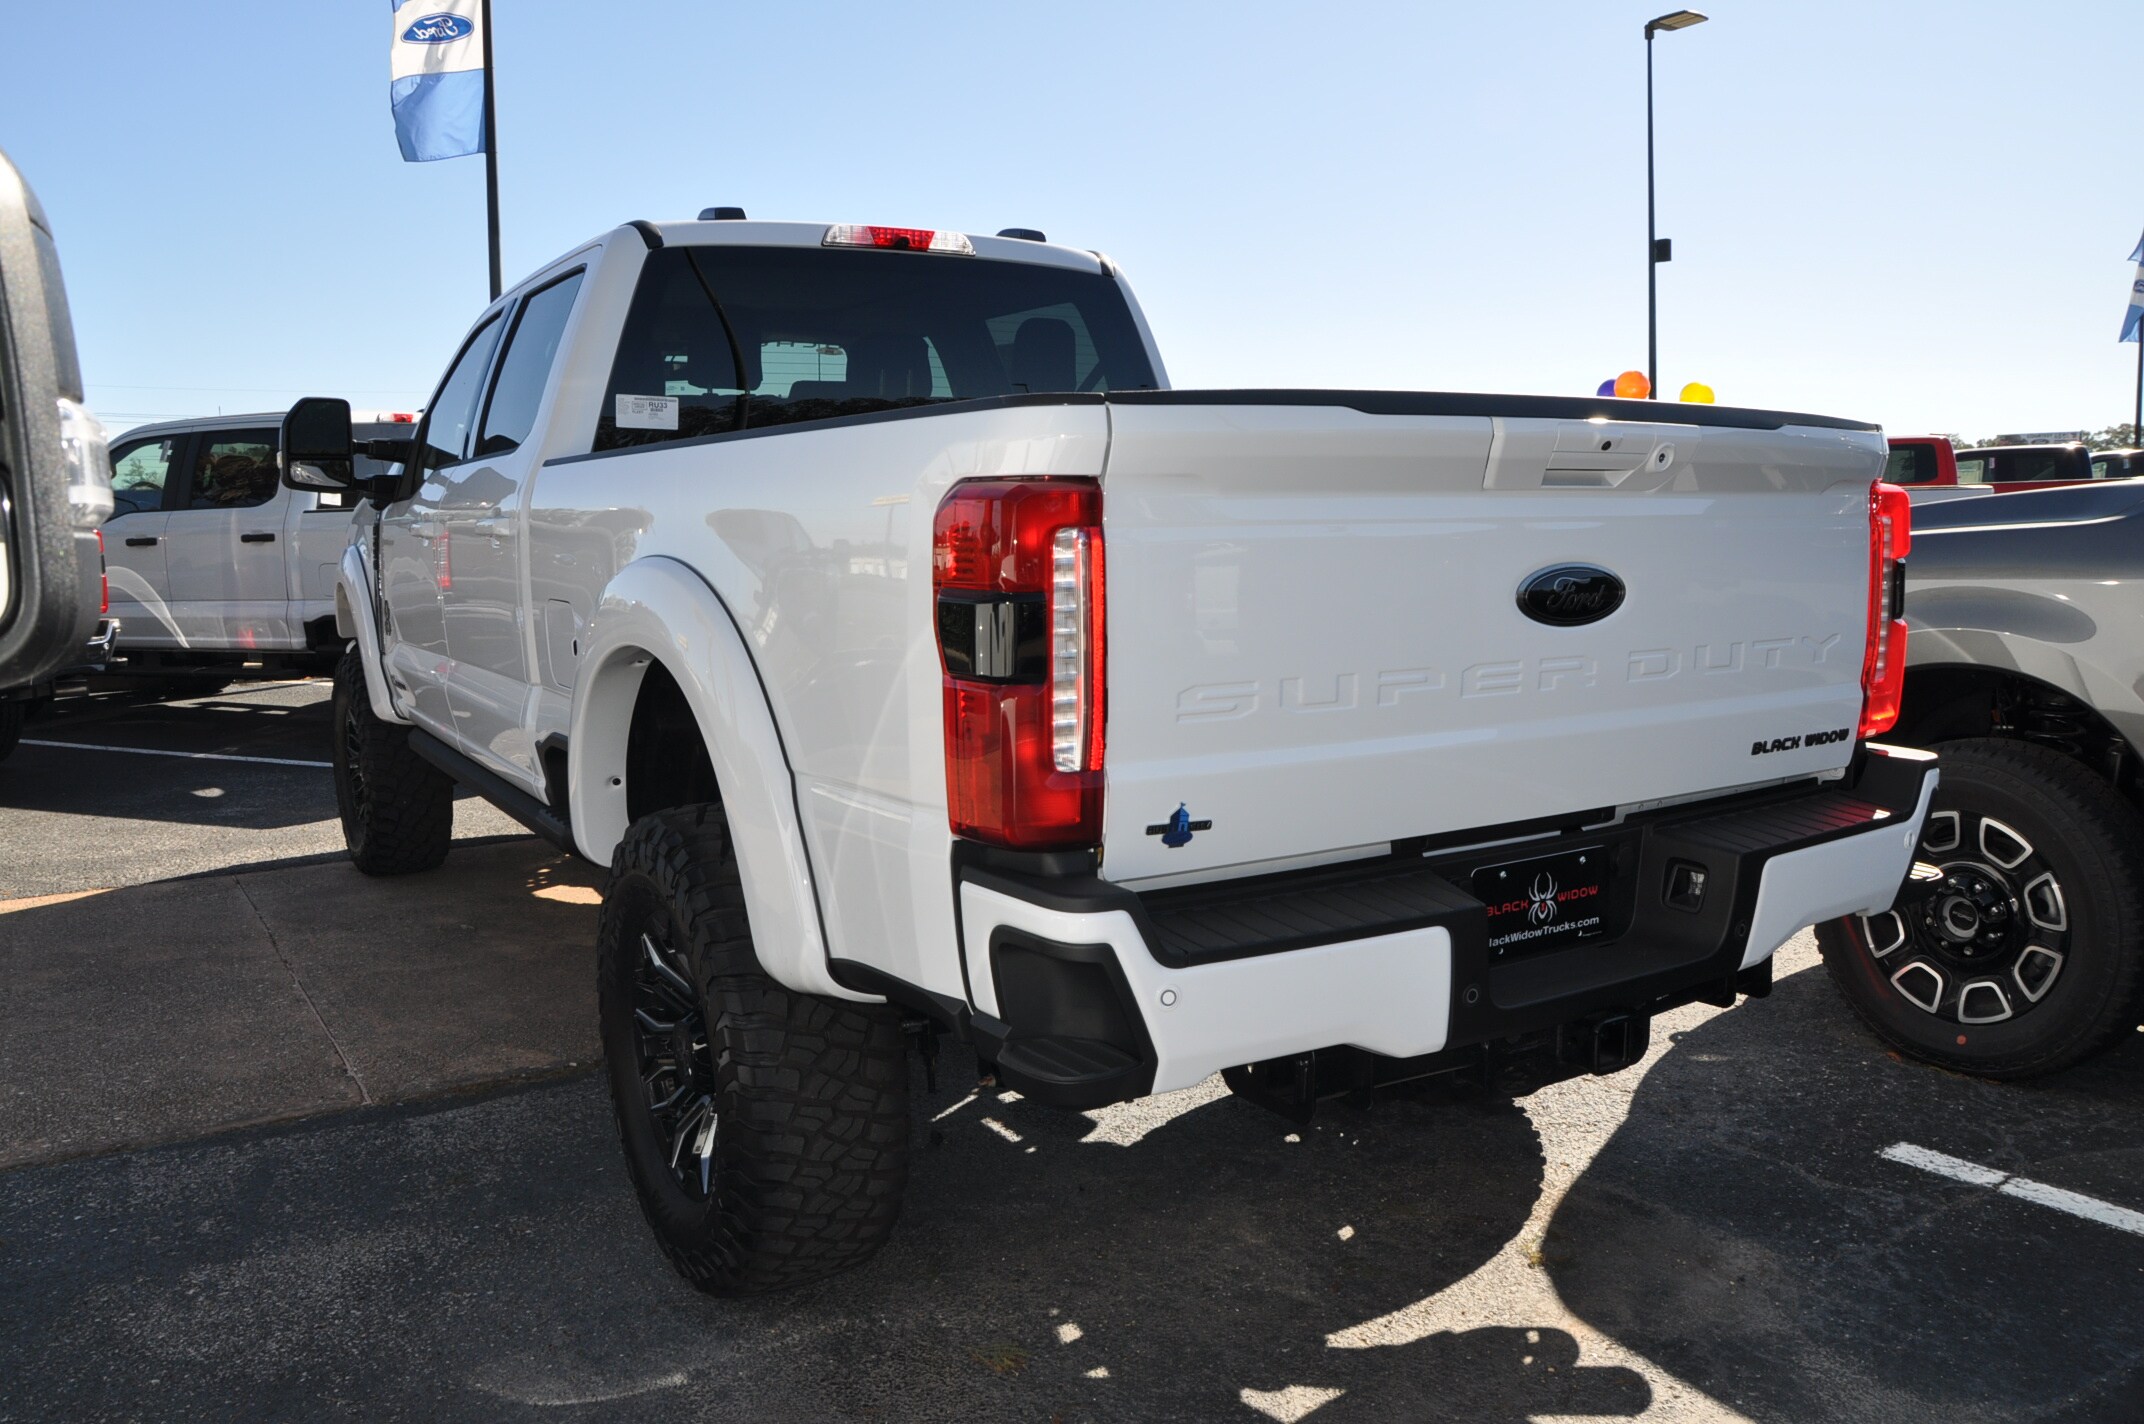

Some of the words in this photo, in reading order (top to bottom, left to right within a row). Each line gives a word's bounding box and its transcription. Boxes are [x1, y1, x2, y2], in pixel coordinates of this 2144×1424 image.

[648, 401, 668, 409] RU33
[1546, 576, 1607, 611] Ford
[1176, 655, 1598, 724] SUPER
[1626, 632, 1842, 683] DUTY
[1751, 735, 1802, 756] BLACK
[1804, 728, 1850, 748] WIDOW
[1557, 884, 1599, 903] WIDOW
[1488, 916, 1601, 948] lackWidowTrucks.com
